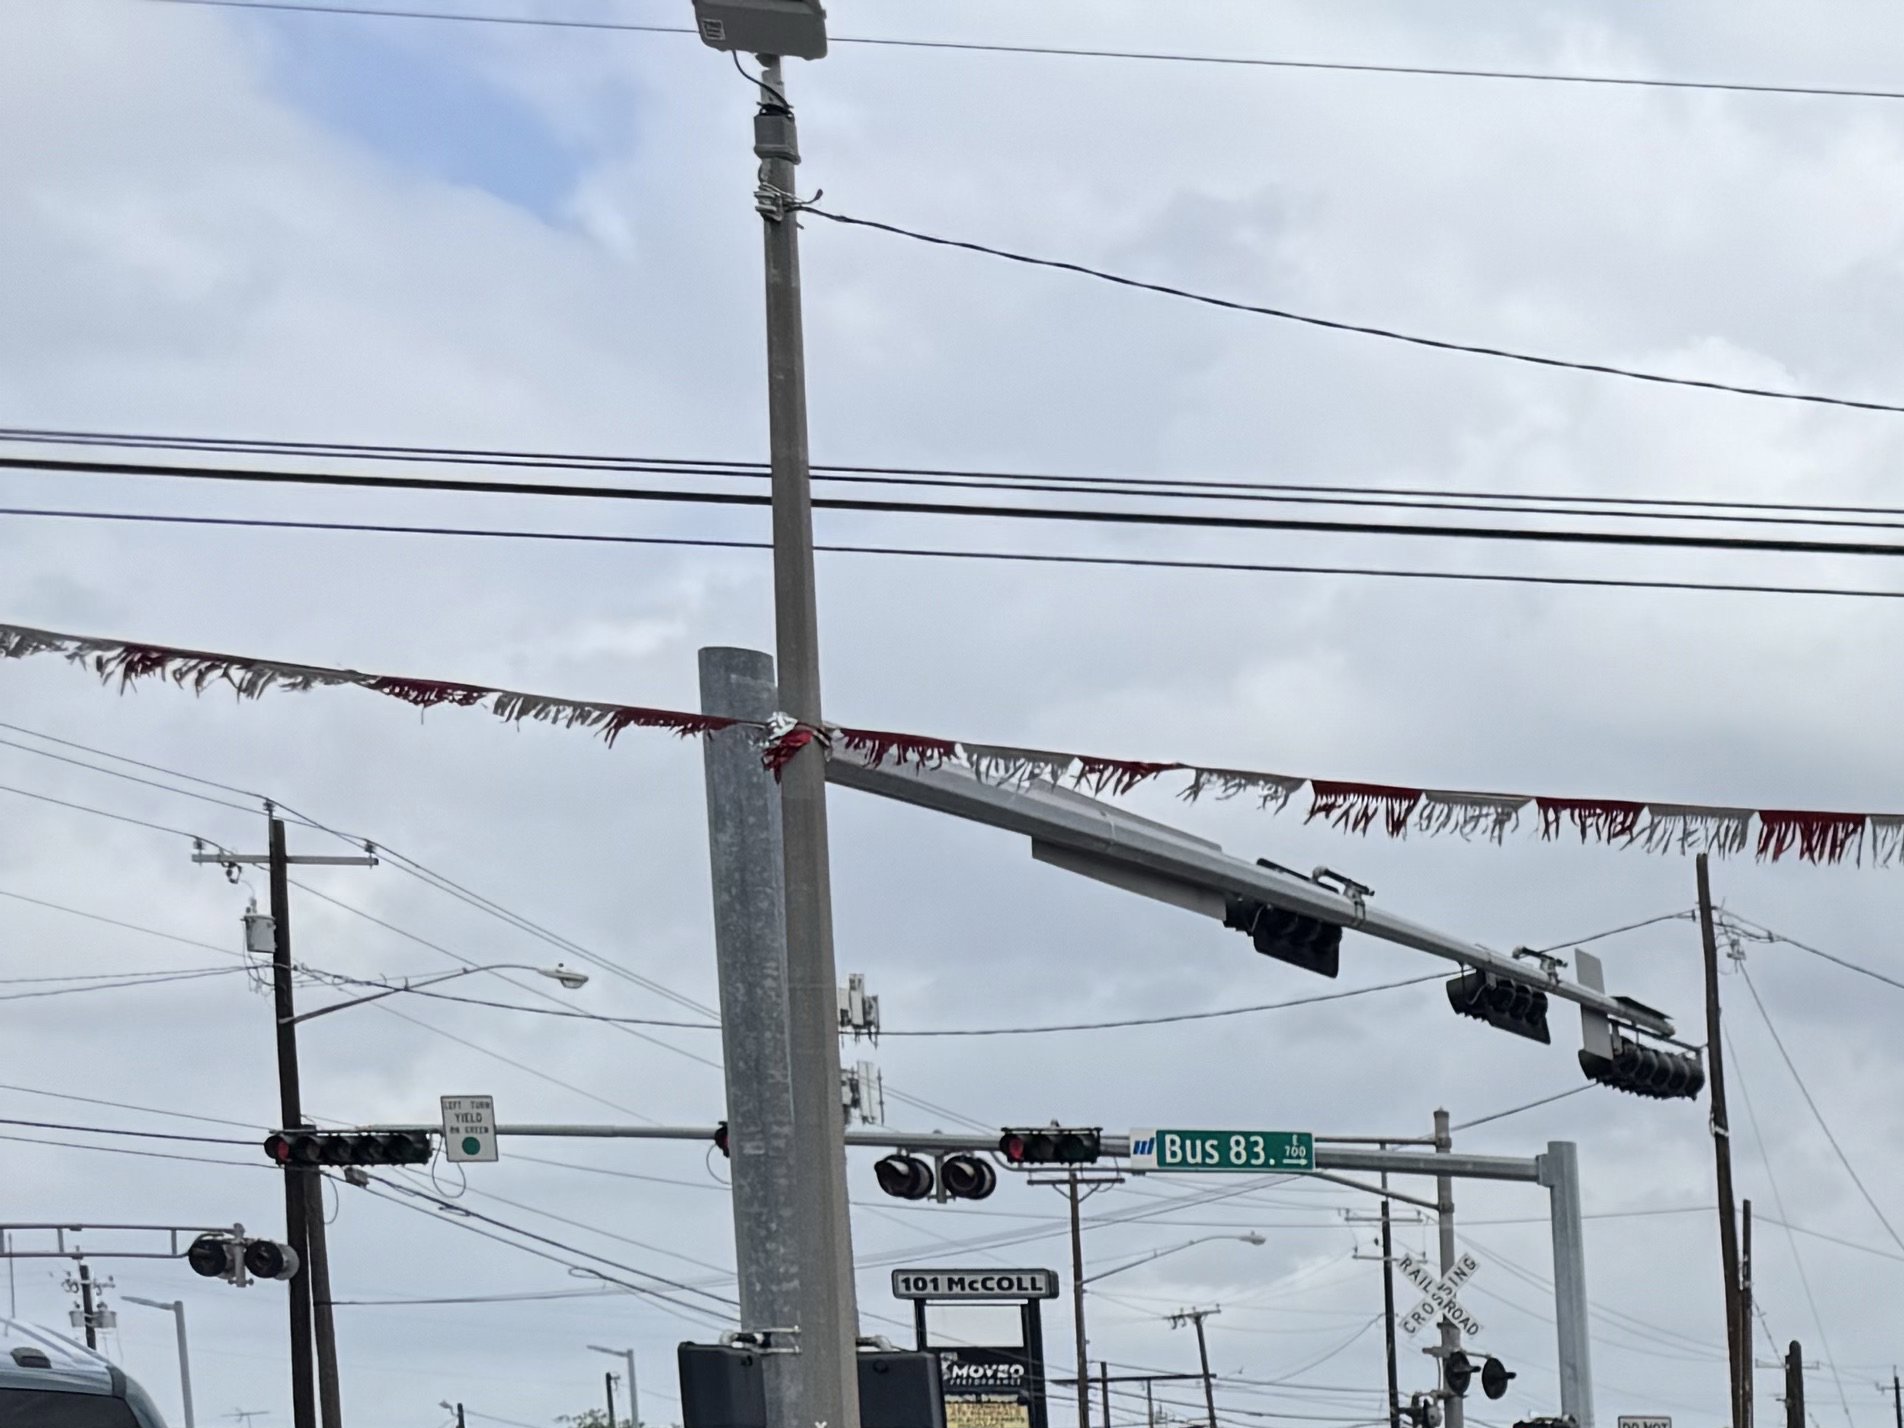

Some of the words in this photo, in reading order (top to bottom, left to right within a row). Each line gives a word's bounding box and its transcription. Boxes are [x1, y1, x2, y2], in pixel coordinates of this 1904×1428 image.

[454, 1112, 482, 1123] YIELD
[1164, 1134, 1219, 1164] Bus
[901, 1276, 940, 1292] 101
[947, 1276, 1043, 1292] McCOLL
